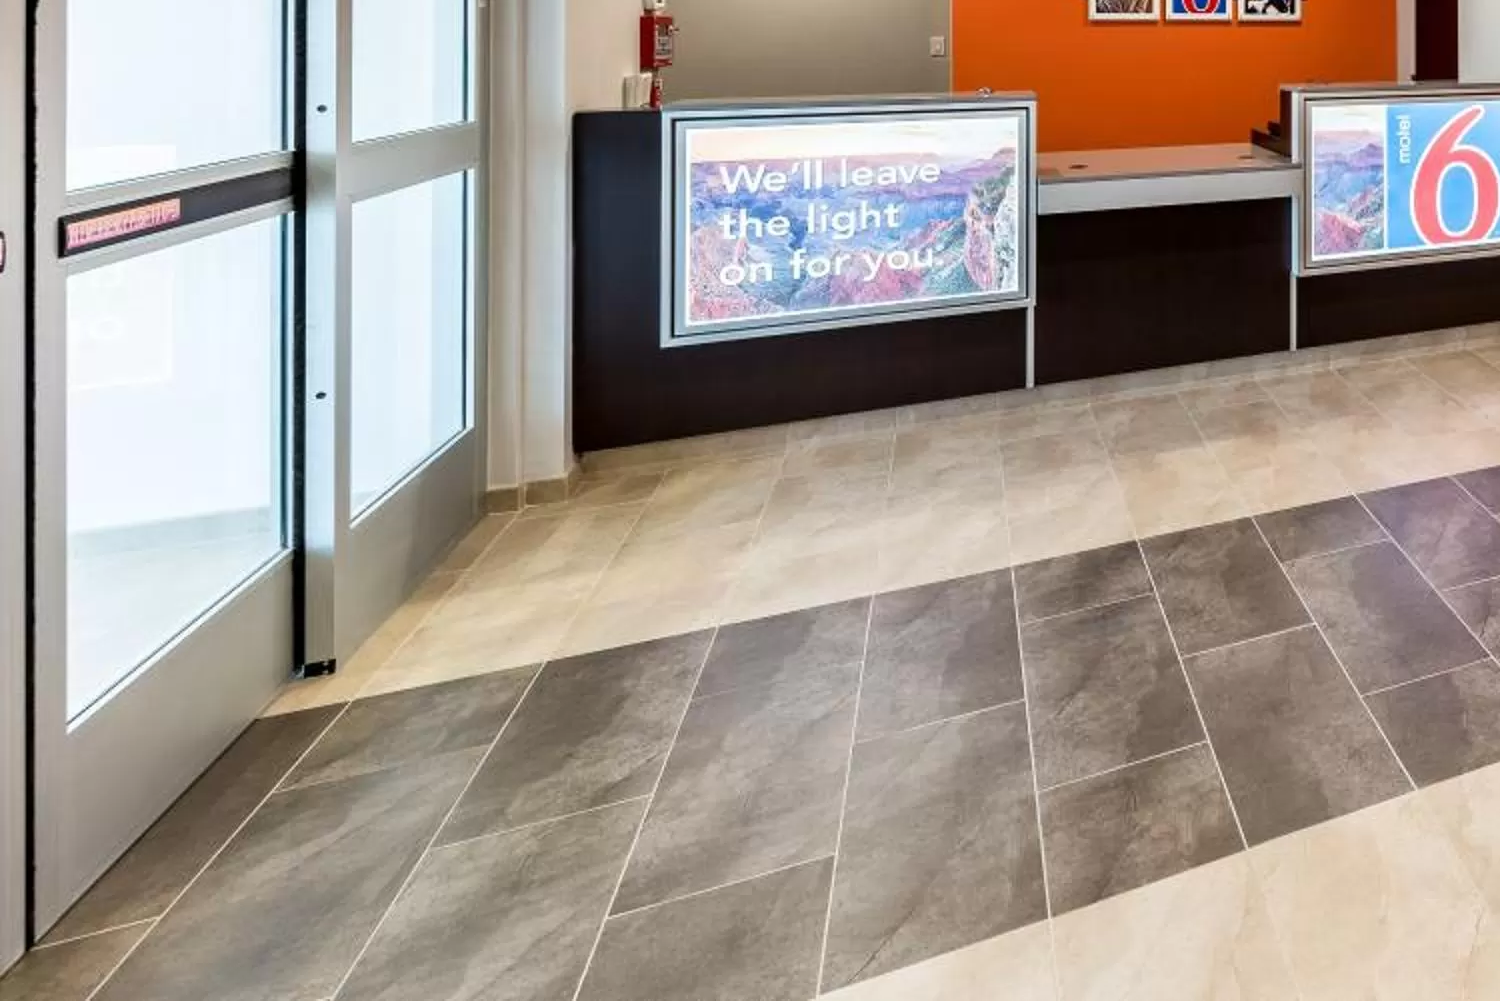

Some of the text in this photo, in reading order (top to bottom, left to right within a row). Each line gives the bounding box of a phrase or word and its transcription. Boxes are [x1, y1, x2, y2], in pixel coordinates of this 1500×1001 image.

[1395, 114, 1412, 164] motel
[840, 157, 942, 189] leave
[719, 200, 901, 241] the light
[719, 244, 946, 287] on for you.
